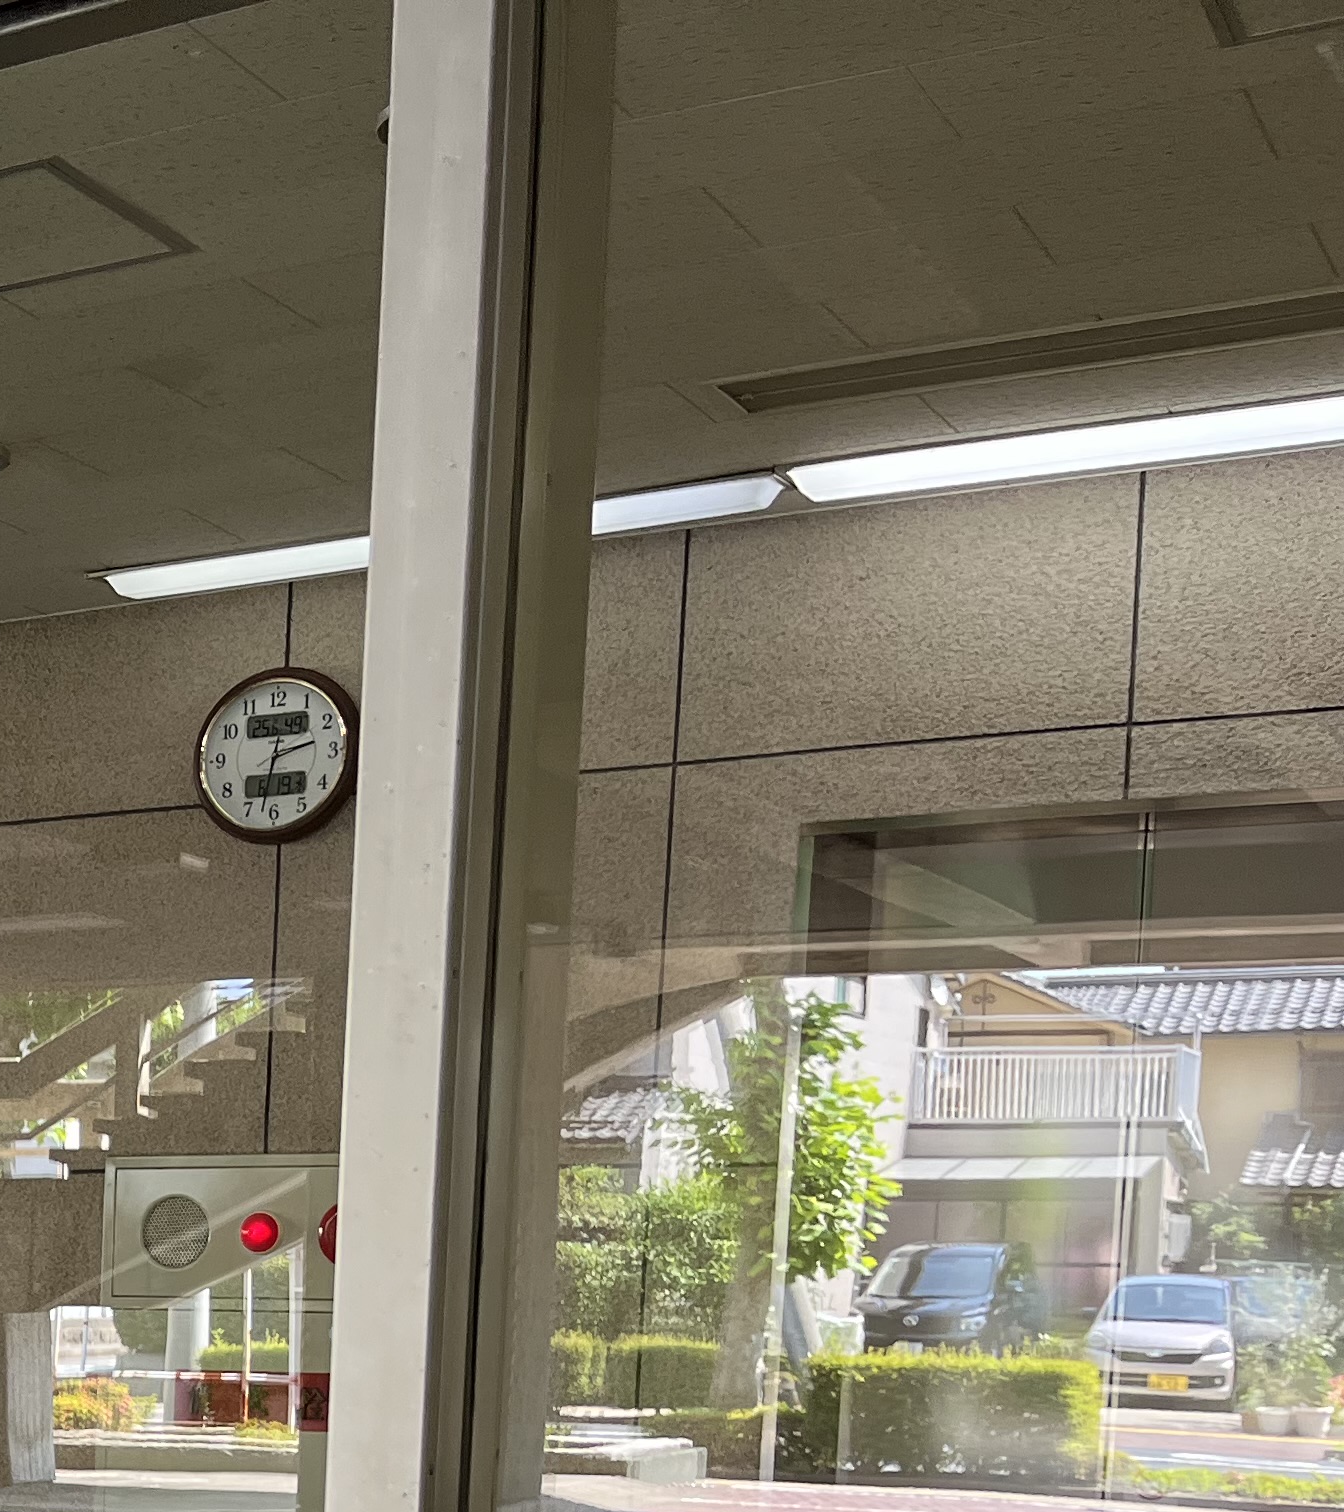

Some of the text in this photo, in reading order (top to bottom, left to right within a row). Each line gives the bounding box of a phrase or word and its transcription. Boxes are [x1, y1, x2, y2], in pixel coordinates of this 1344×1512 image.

[243, 698, 257, 716] 11
[270, 691, 287, 707] 12
[304, 693, 310, 709] 1
[322, 713, 333, 730] 2
[223, 723, 239, 740] 10
[327, 741, 339, 759] 3
[215, 753, 226, 770] 9
[222, 782, 233, 798] 8
[316, 774, 329, 790] 4
[243, 801, 253, 818] 7
[268, 803, 279, 821] 6
[296, 796, 307, 813] 5
